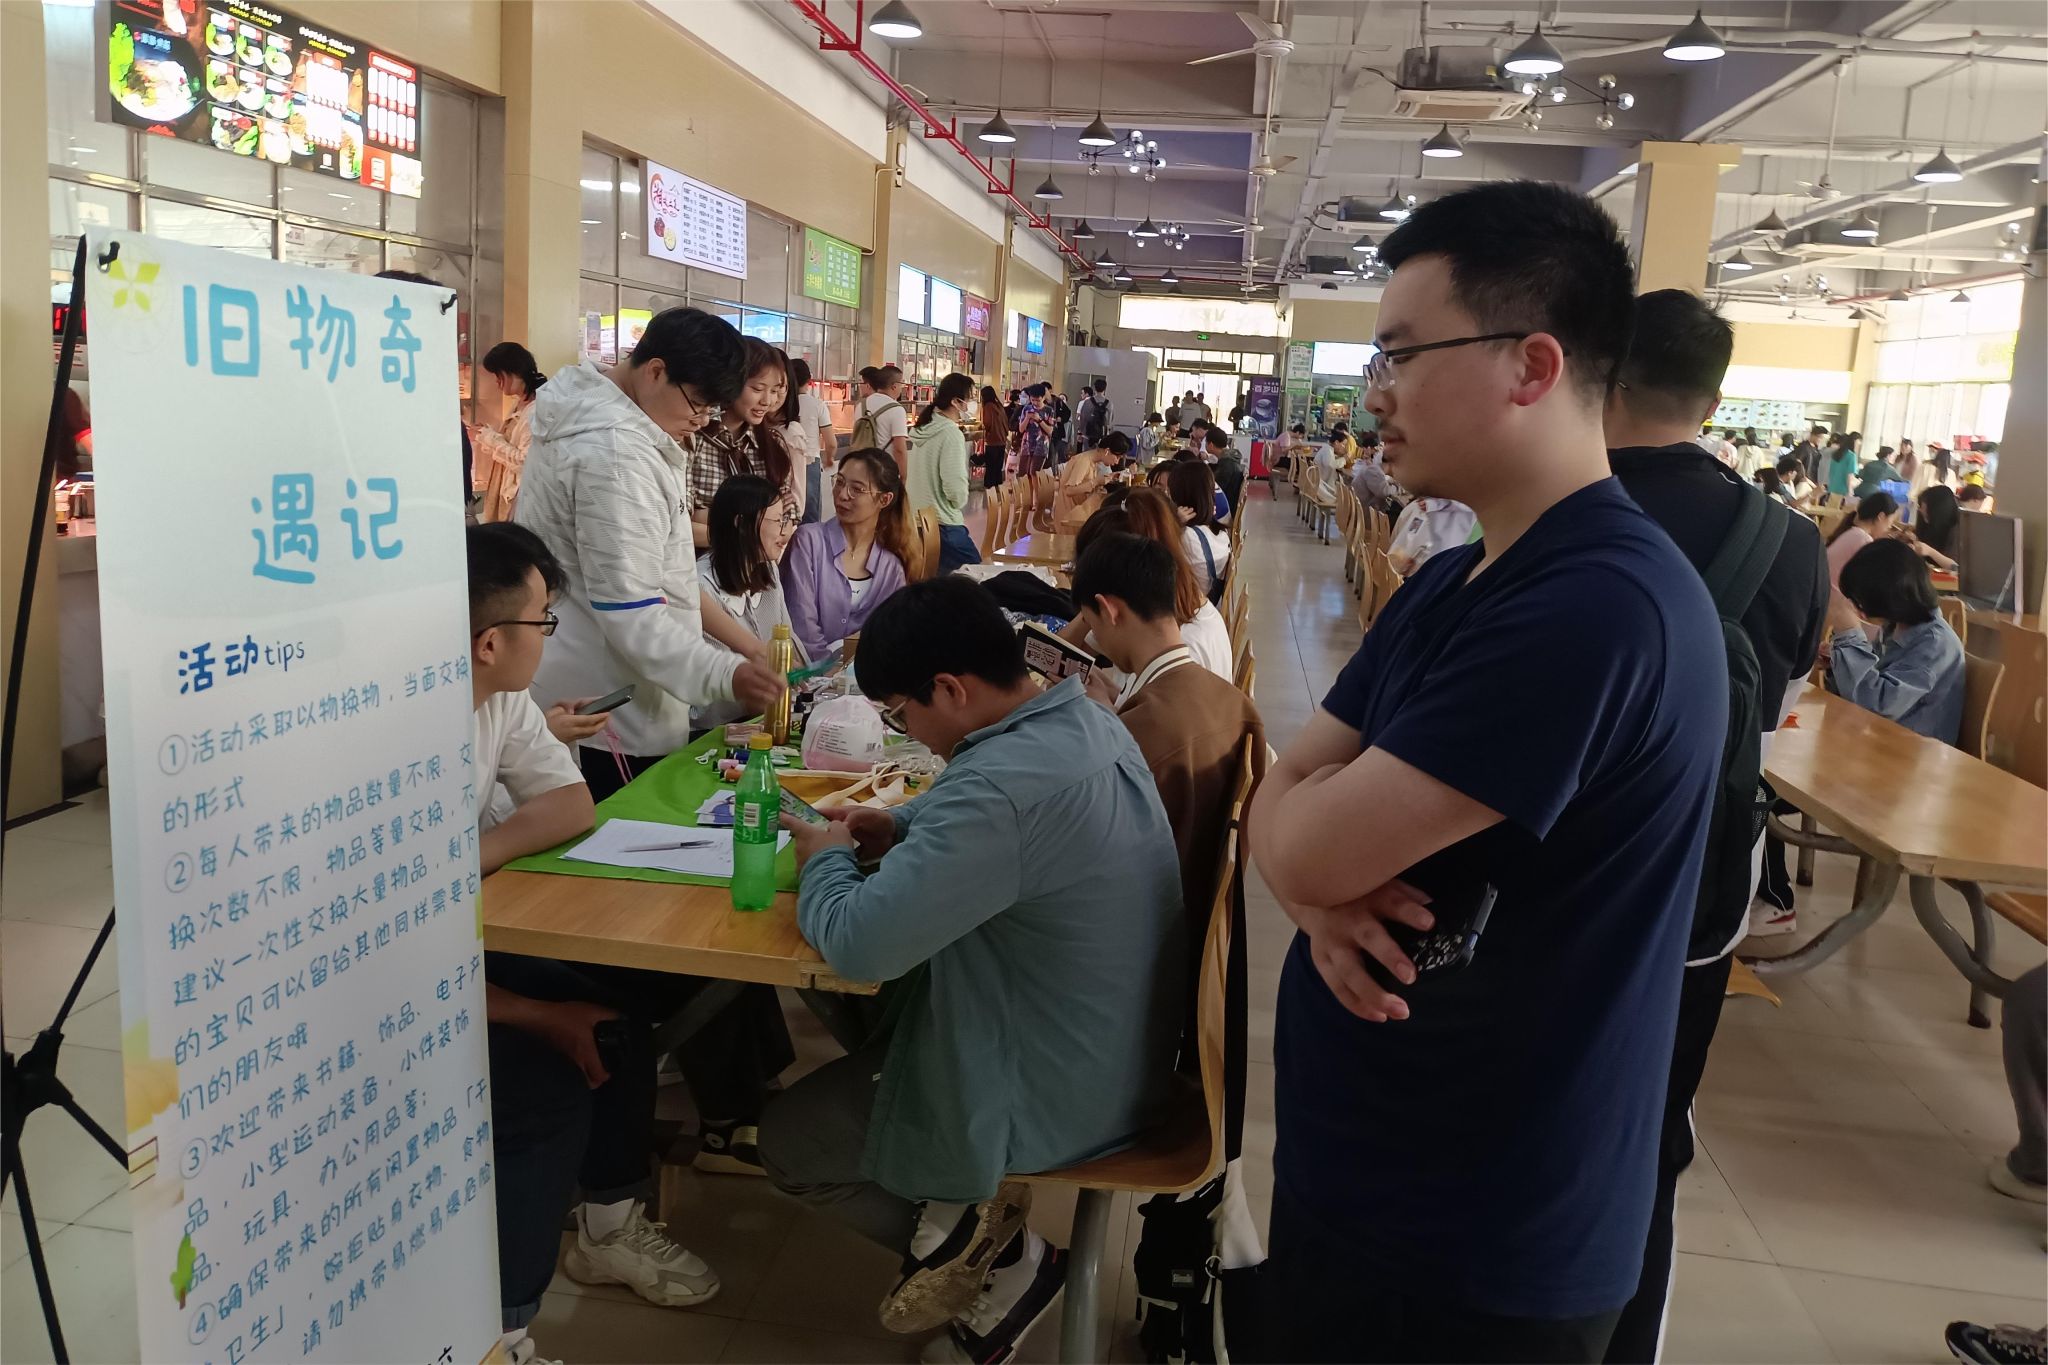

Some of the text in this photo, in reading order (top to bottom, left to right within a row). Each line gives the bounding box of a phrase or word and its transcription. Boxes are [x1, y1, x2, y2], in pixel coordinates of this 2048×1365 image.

[181, 283, 423, 393] 旧物奇
[251, 472, 404, 584] 遇记
[162, 775, 246, 834] 的形式
[177, 1021, 309, 1121] 们的朋友哦
